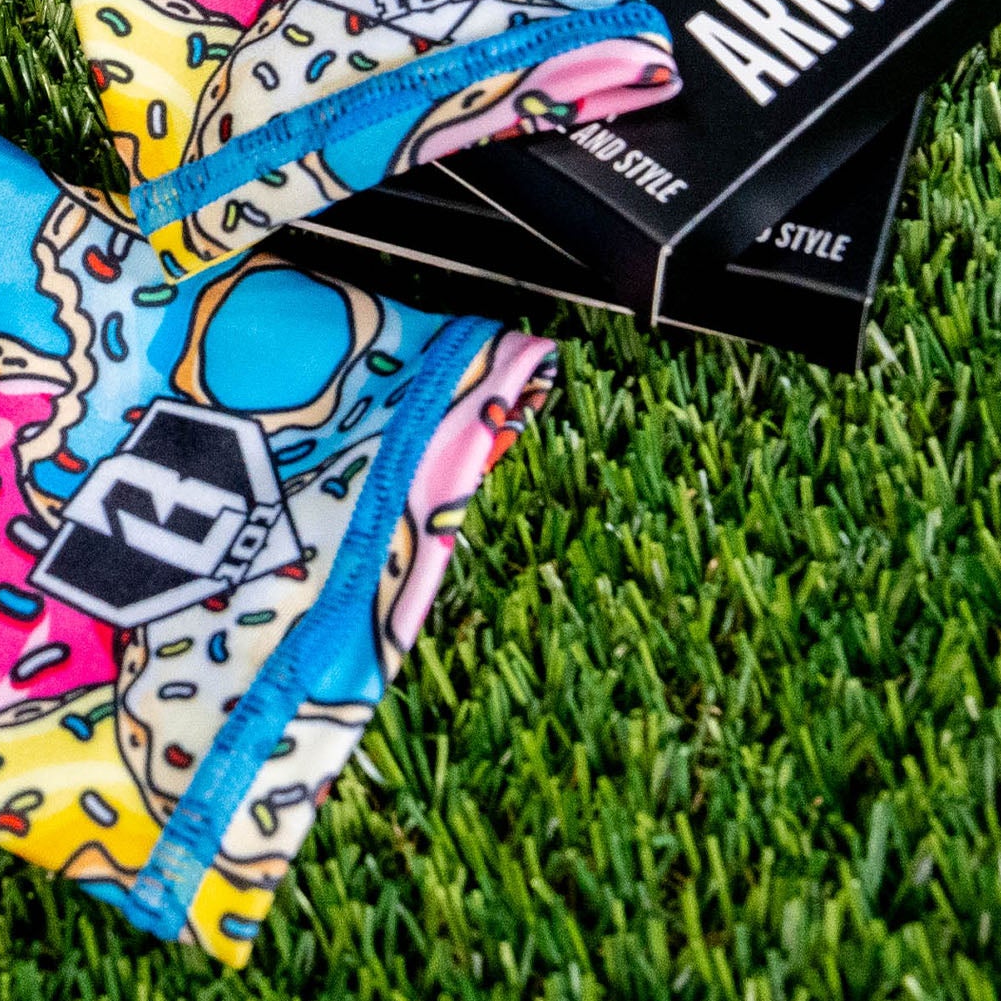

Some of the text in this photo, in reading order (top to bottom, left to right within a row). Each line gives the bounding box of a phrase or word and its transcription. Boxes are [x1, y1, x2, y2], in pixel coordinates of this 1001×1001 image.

[569, 122, 690, 204] AND STYLE
[774, 221, 852, 262] STYLE
